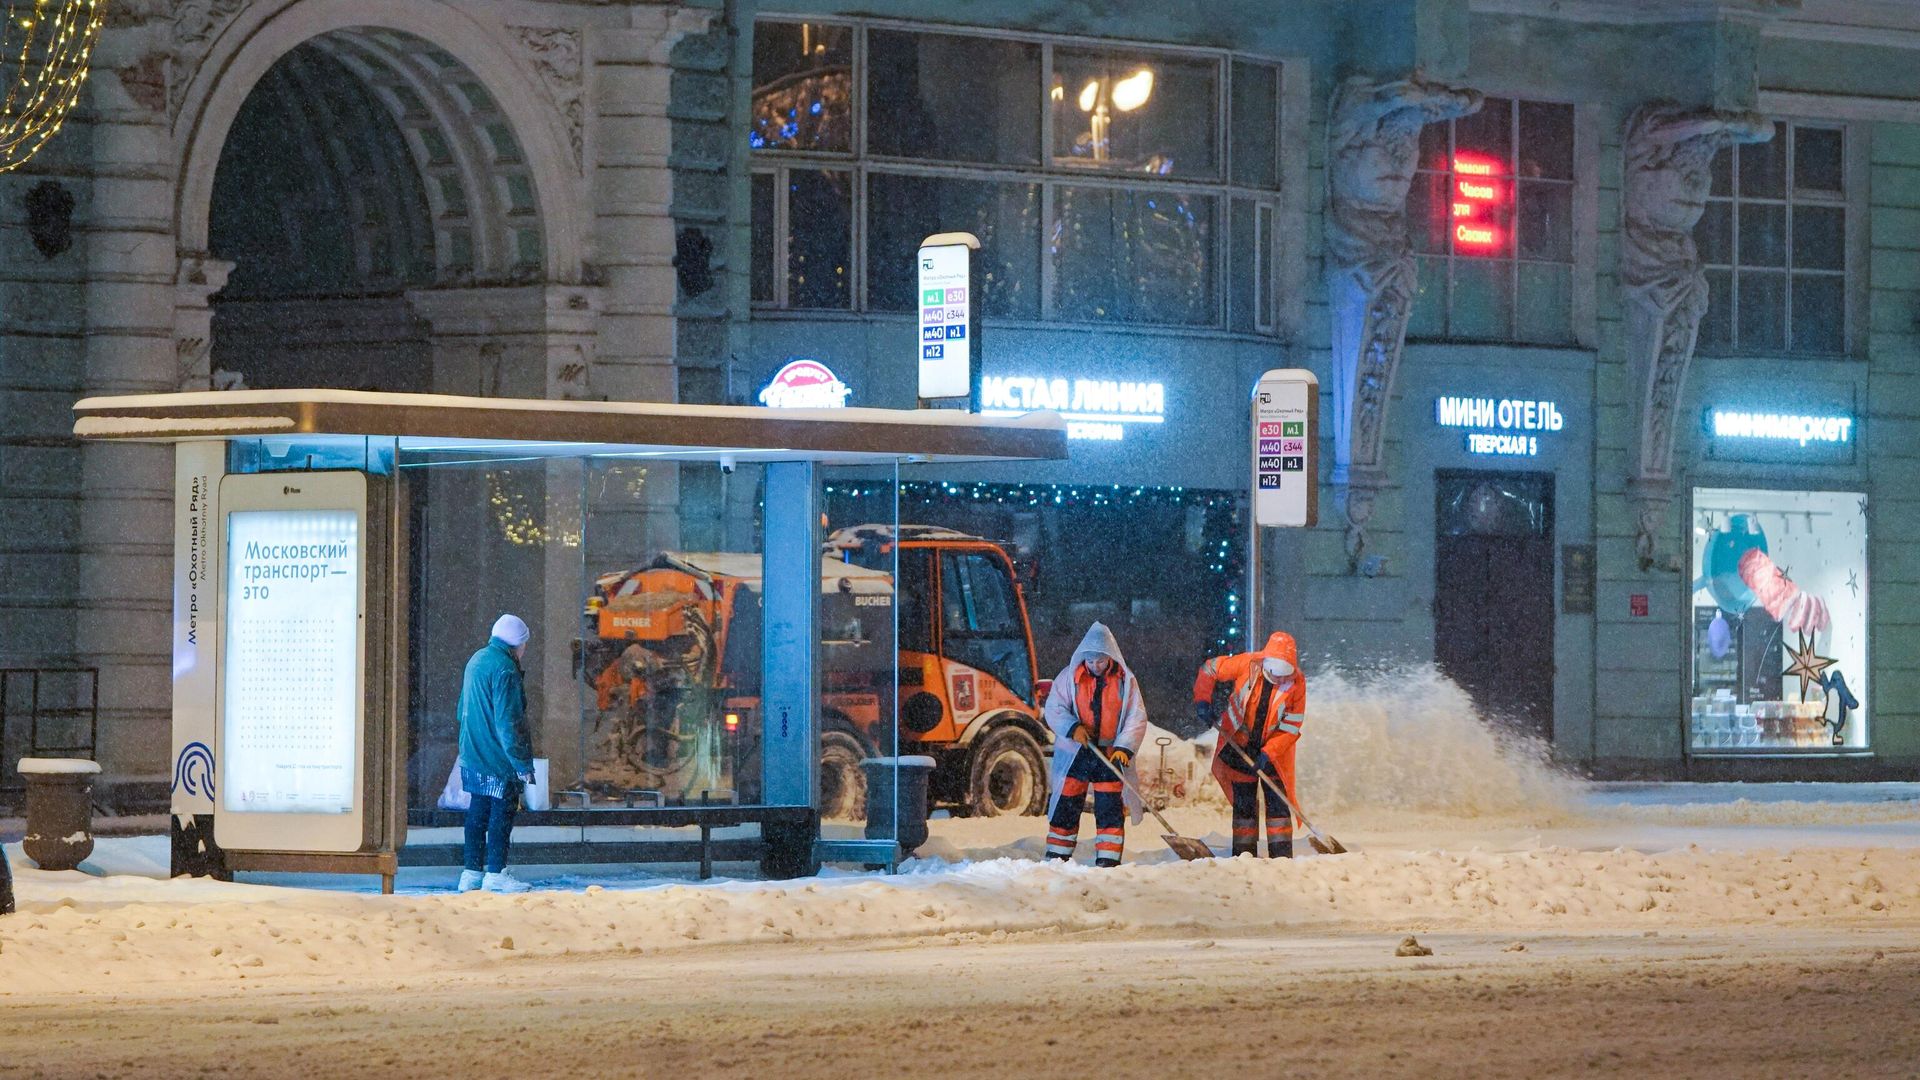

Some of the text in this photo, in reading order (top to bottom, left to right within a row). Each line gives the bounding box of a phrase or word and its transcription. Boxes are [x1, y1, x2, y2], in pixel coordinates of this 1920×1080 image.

[927, 292, 964, 303] м1 е30
[925, 310, 965, 322] м40 с344
[925, 326, 961, 340] м40 н1
[926, 346, 941, 357] н12
[982, 377, 1164, 413] ИСТАЯ ЛИНИЯ
[1440, 397, 1563, 431] МИНИ ОТЕЛЬ
[1262, 425, 1299, 435] е30 м1
[1261, 443, 1303, 452] м40 с344
[1469, 434, 1537, 456] ТВЕРСКАЯ 5
[1261, 459, 1298, 469] м40 н1
[1263, 476, 1277, 486] н12
[245, 539, 348, 560] Московский
[189, 476, 199, 645] Метро «Охотный Ряд»
[244, 564, 329, 583] транспорт
[243, 585, 269, 600] это
[855, 597, 891, 607] BUCHER
[613, 617, 652, 628] BUCHER
